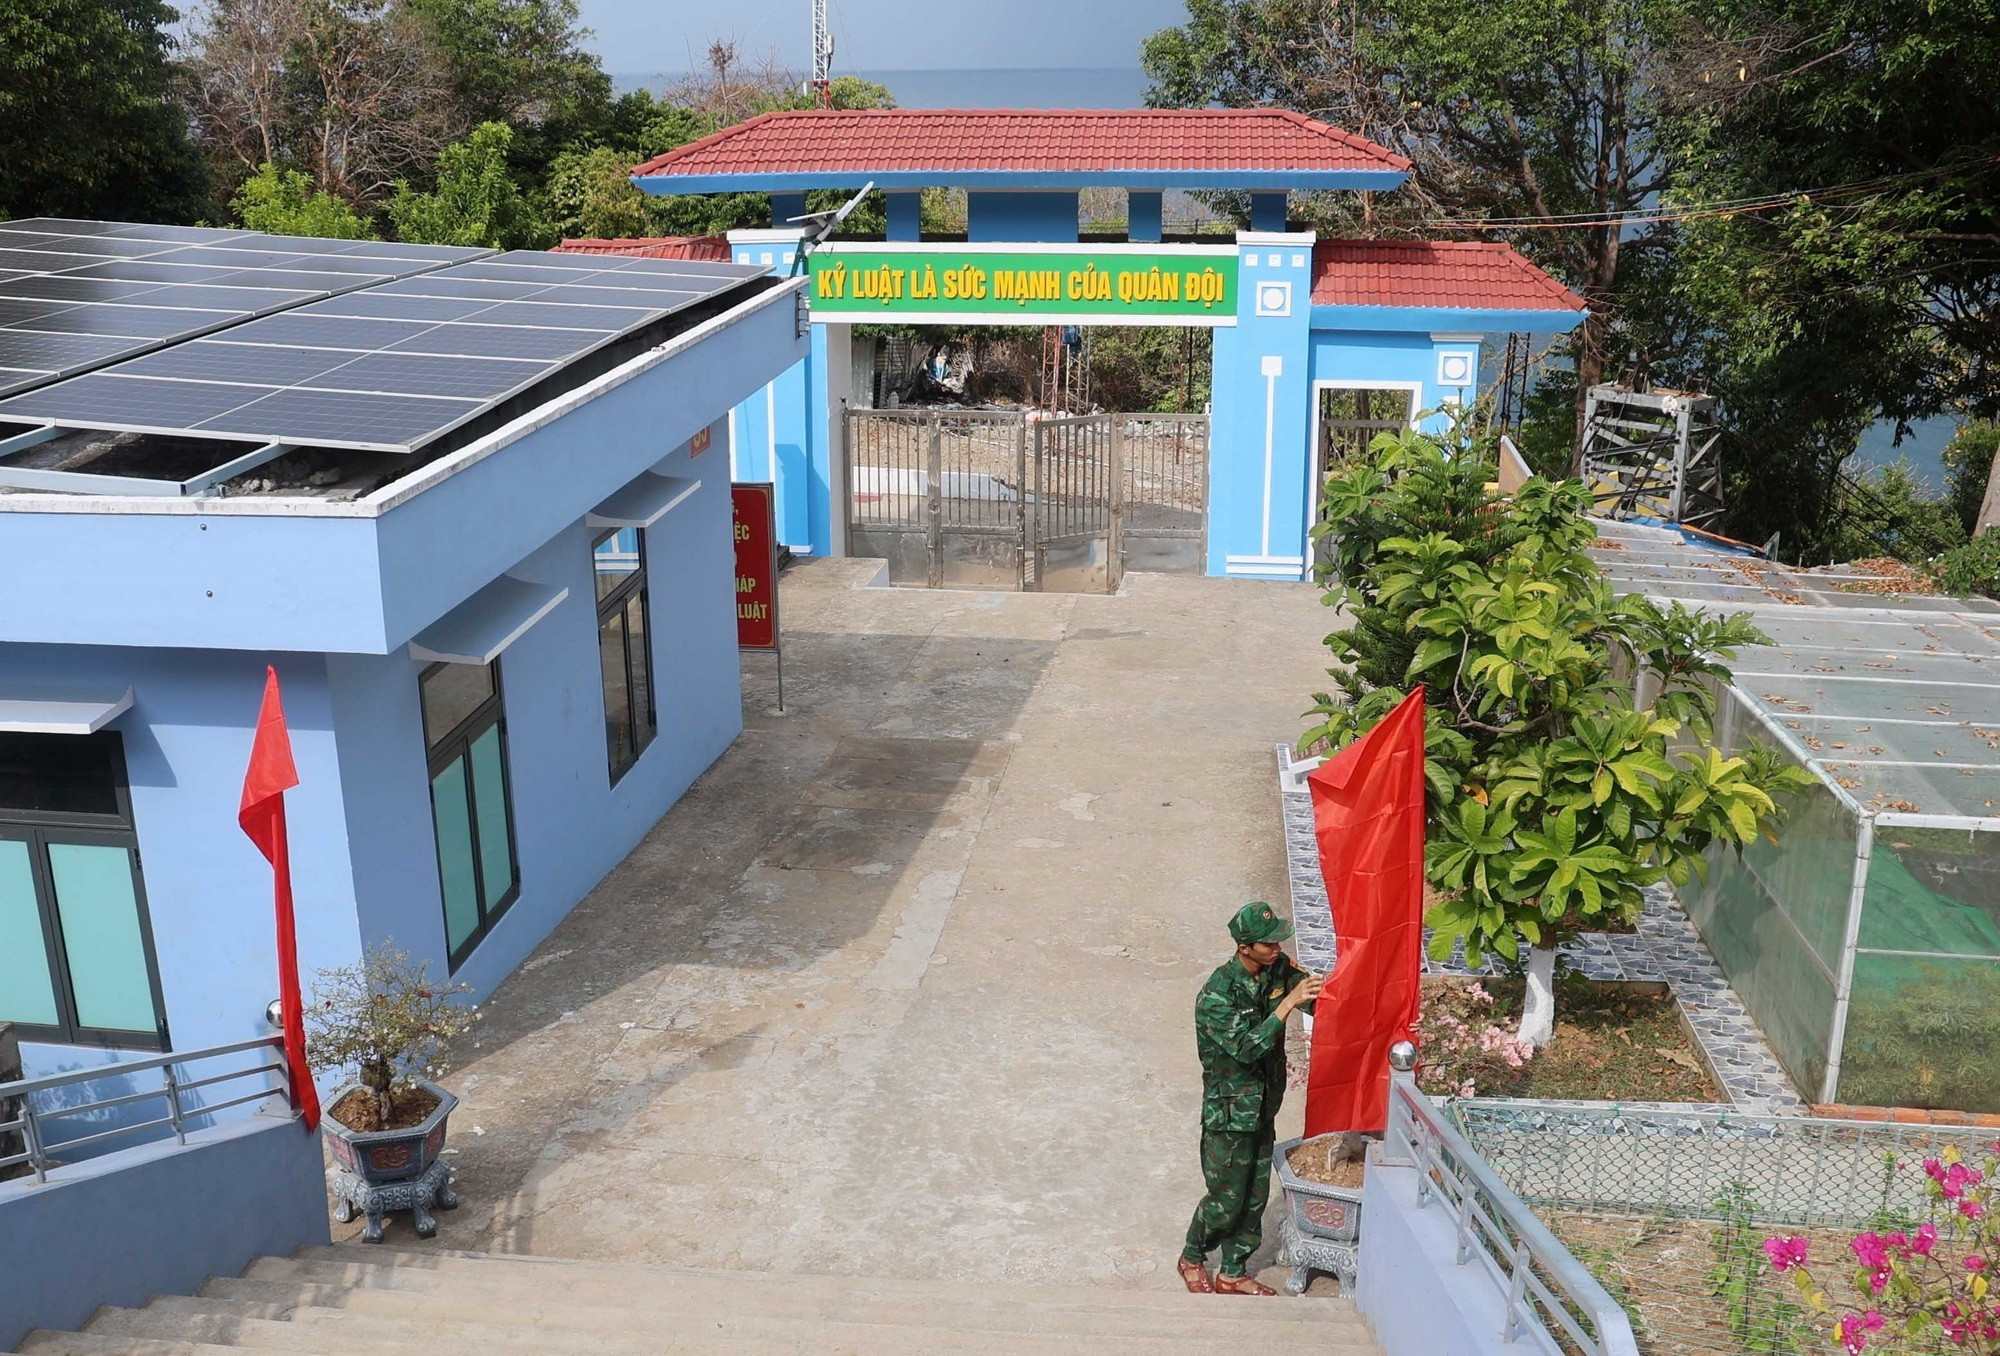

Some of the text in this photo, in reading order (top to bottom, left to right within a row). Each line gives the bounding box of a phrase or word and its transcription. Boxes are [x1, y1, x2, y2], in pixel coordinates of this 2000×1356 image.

[818, 261, 1224, 308] KỶ LUẬT LÀ SỨC MẠNH CỦA QUÂN ĐỘI
[738, 601, 768, 622] LUẬT
